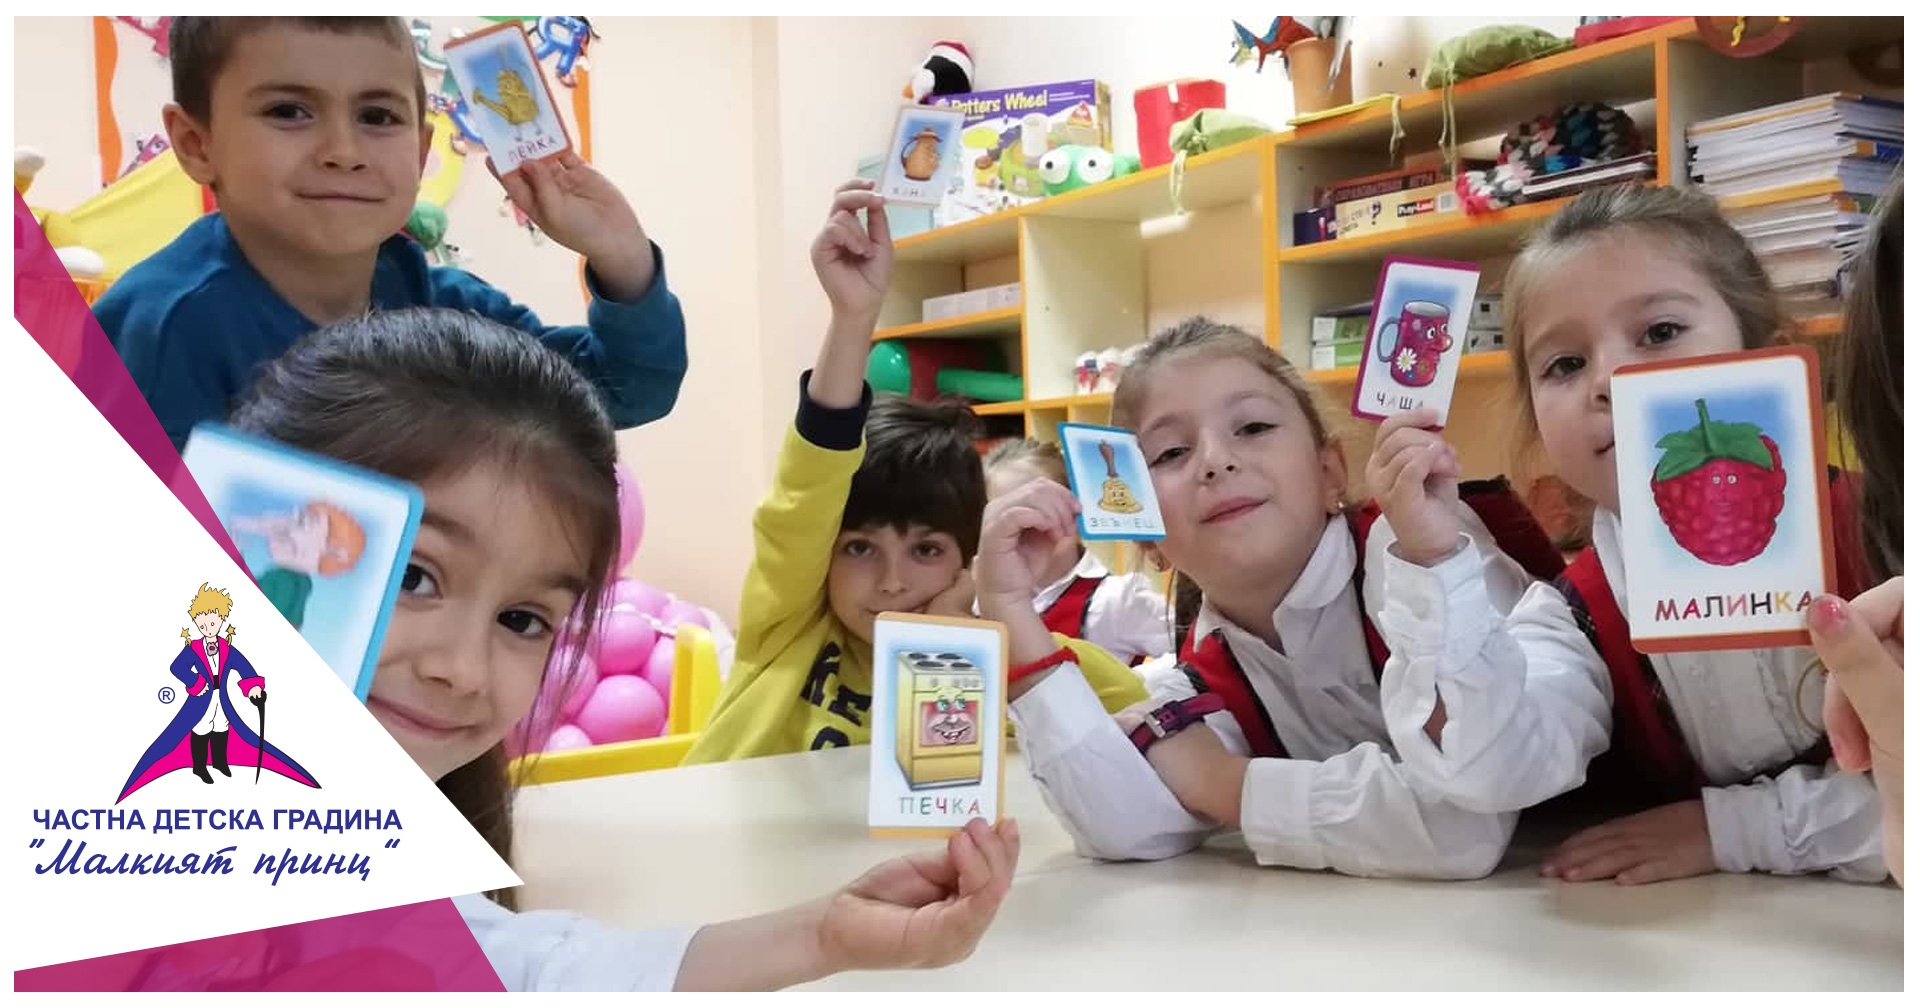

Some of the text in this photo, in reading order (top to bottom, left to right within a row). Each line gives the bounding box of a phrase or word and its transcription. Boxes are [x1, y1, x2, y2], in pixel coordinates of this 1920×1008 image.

[1004, 89, 1048, 111] Wheel
[1376, 391, 1424, 410] ЧАША
[1655, 591, 1812, 621] МАЛИНКА
[899, 796, 981, 815] ПЕЧКА
